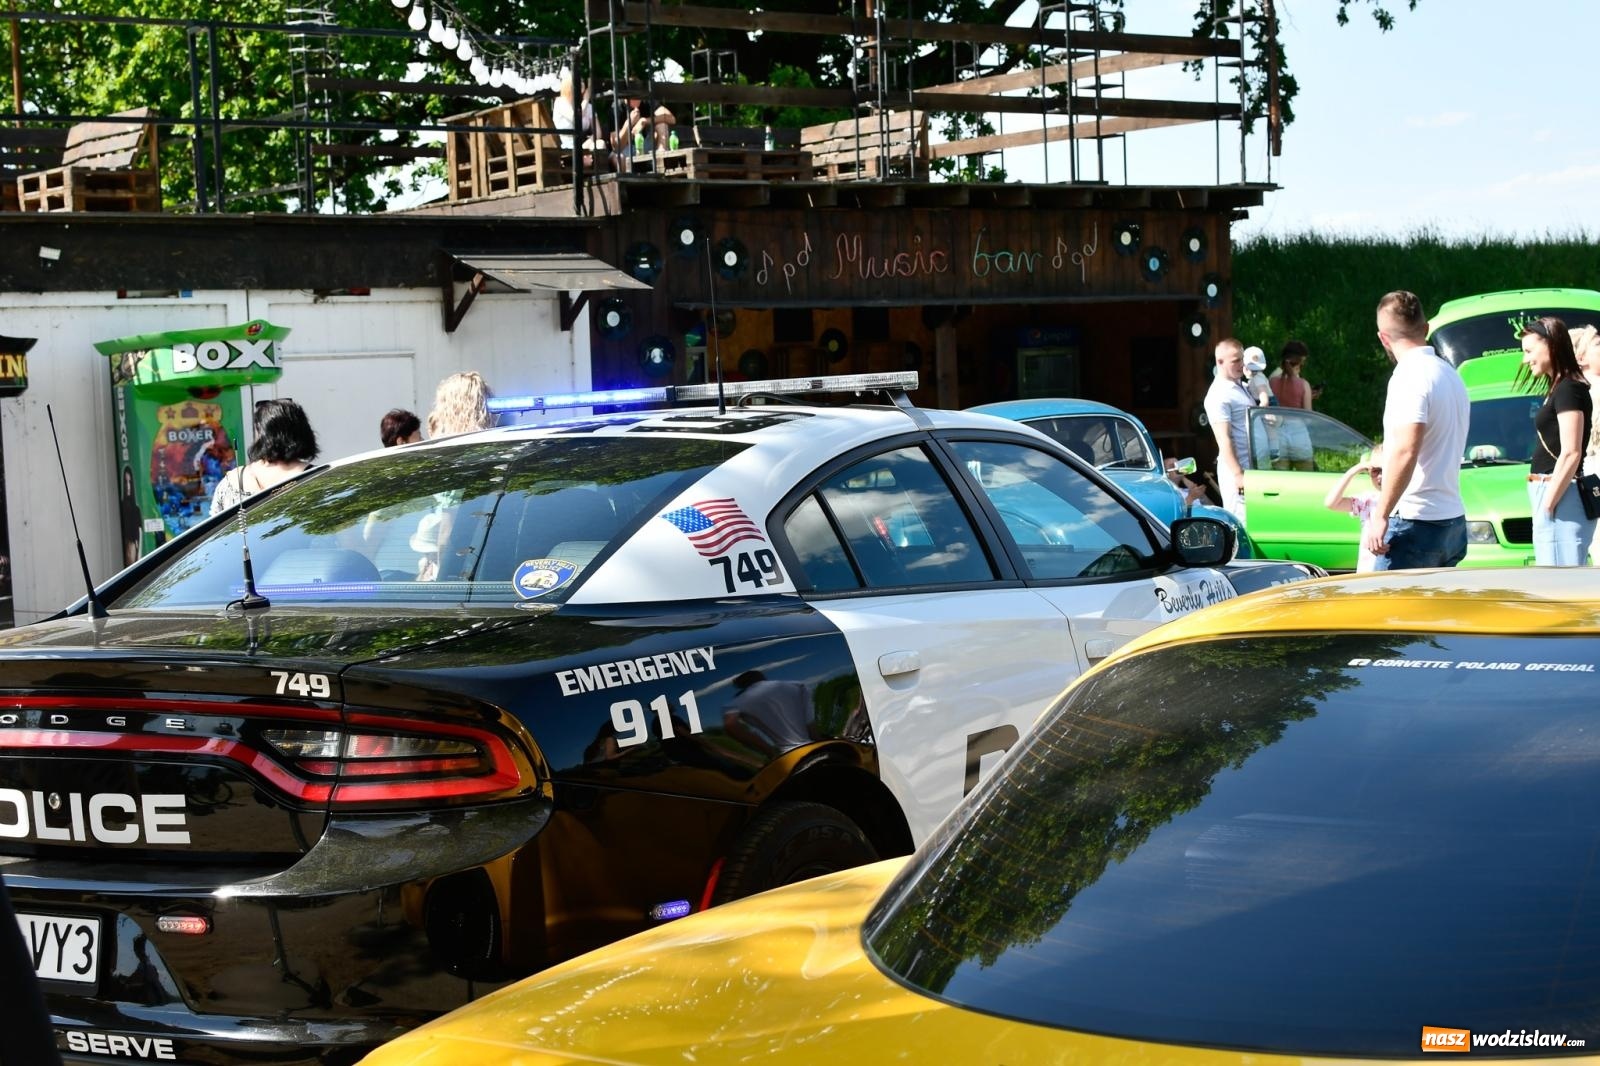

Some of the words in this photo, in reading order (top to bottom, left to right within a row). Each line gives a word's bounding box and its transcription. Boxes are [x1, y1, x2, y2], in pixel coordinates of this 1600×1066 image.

[830, 232, 948, 280] Music
[973, 227, 1042, 277] bar
[168, 428, 213, 442] BOXER
[708, 548, 785, 594] 749
[1154, 587, 1204, 614] Beverly
[270, 670, 331, 698] 749
[555, 646, 717, 697] EMERGENCY
[1372, 658, 1453, 669] CORVETTE
[1455, 661, 1521, 670] POLAND
[1524, 662, 1596, 672] OFFICIAL
[609, 689, 704, 748] 911
[30, 920, 94, 975] VY3
[66, 1030, 176, 1060] SERVE
